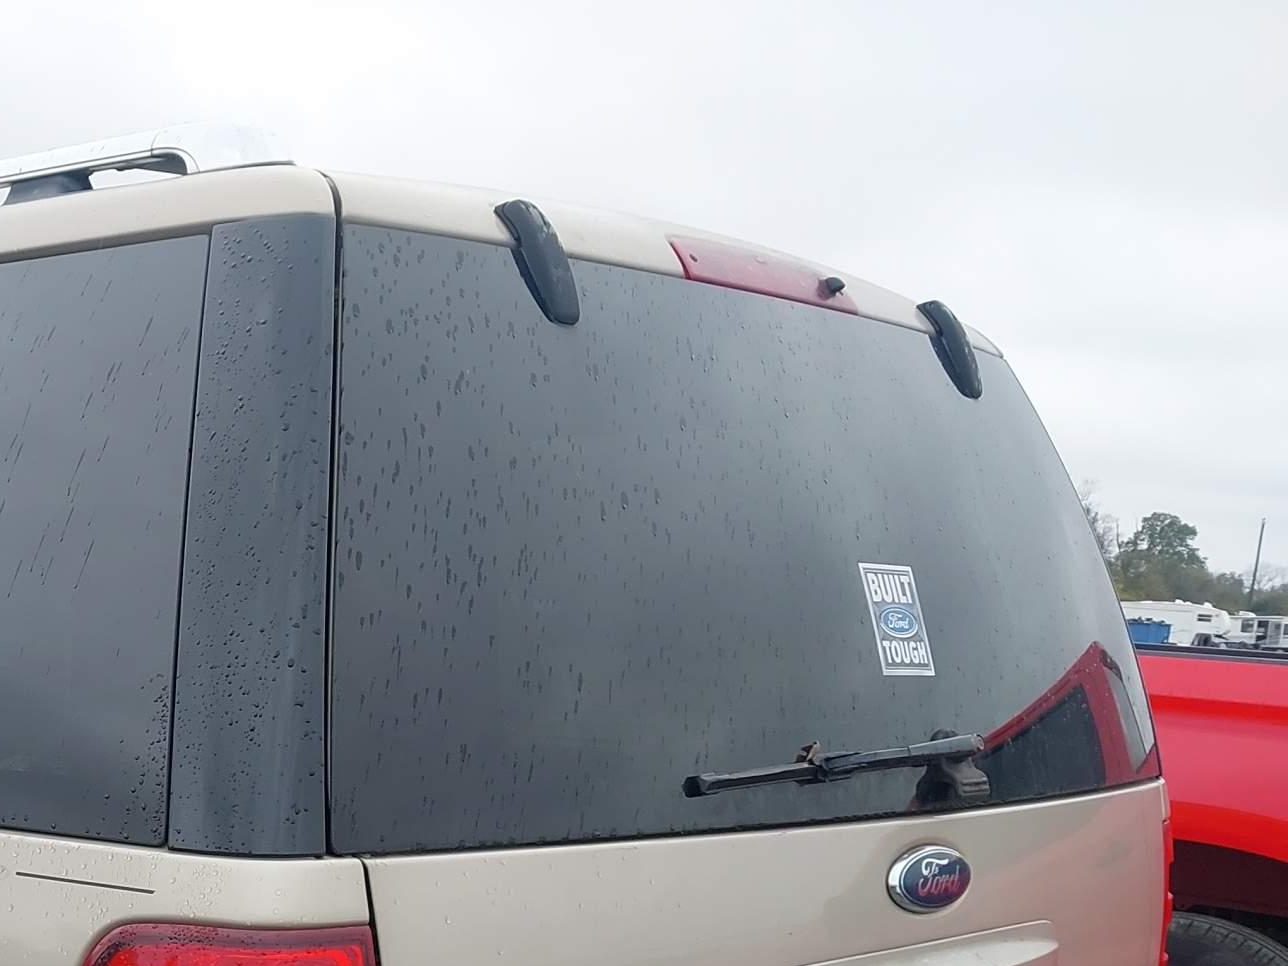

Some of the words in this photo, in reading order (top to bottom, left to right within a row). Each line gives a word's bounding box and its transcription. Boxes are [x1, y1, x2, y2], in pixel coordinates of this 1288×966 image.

[865, 571, 913, 604] BUILT
[887, 612, 910, 629] Ford
[881, 639, 929, 664] TOUGH
[918, 858, 960, 897] Ford
